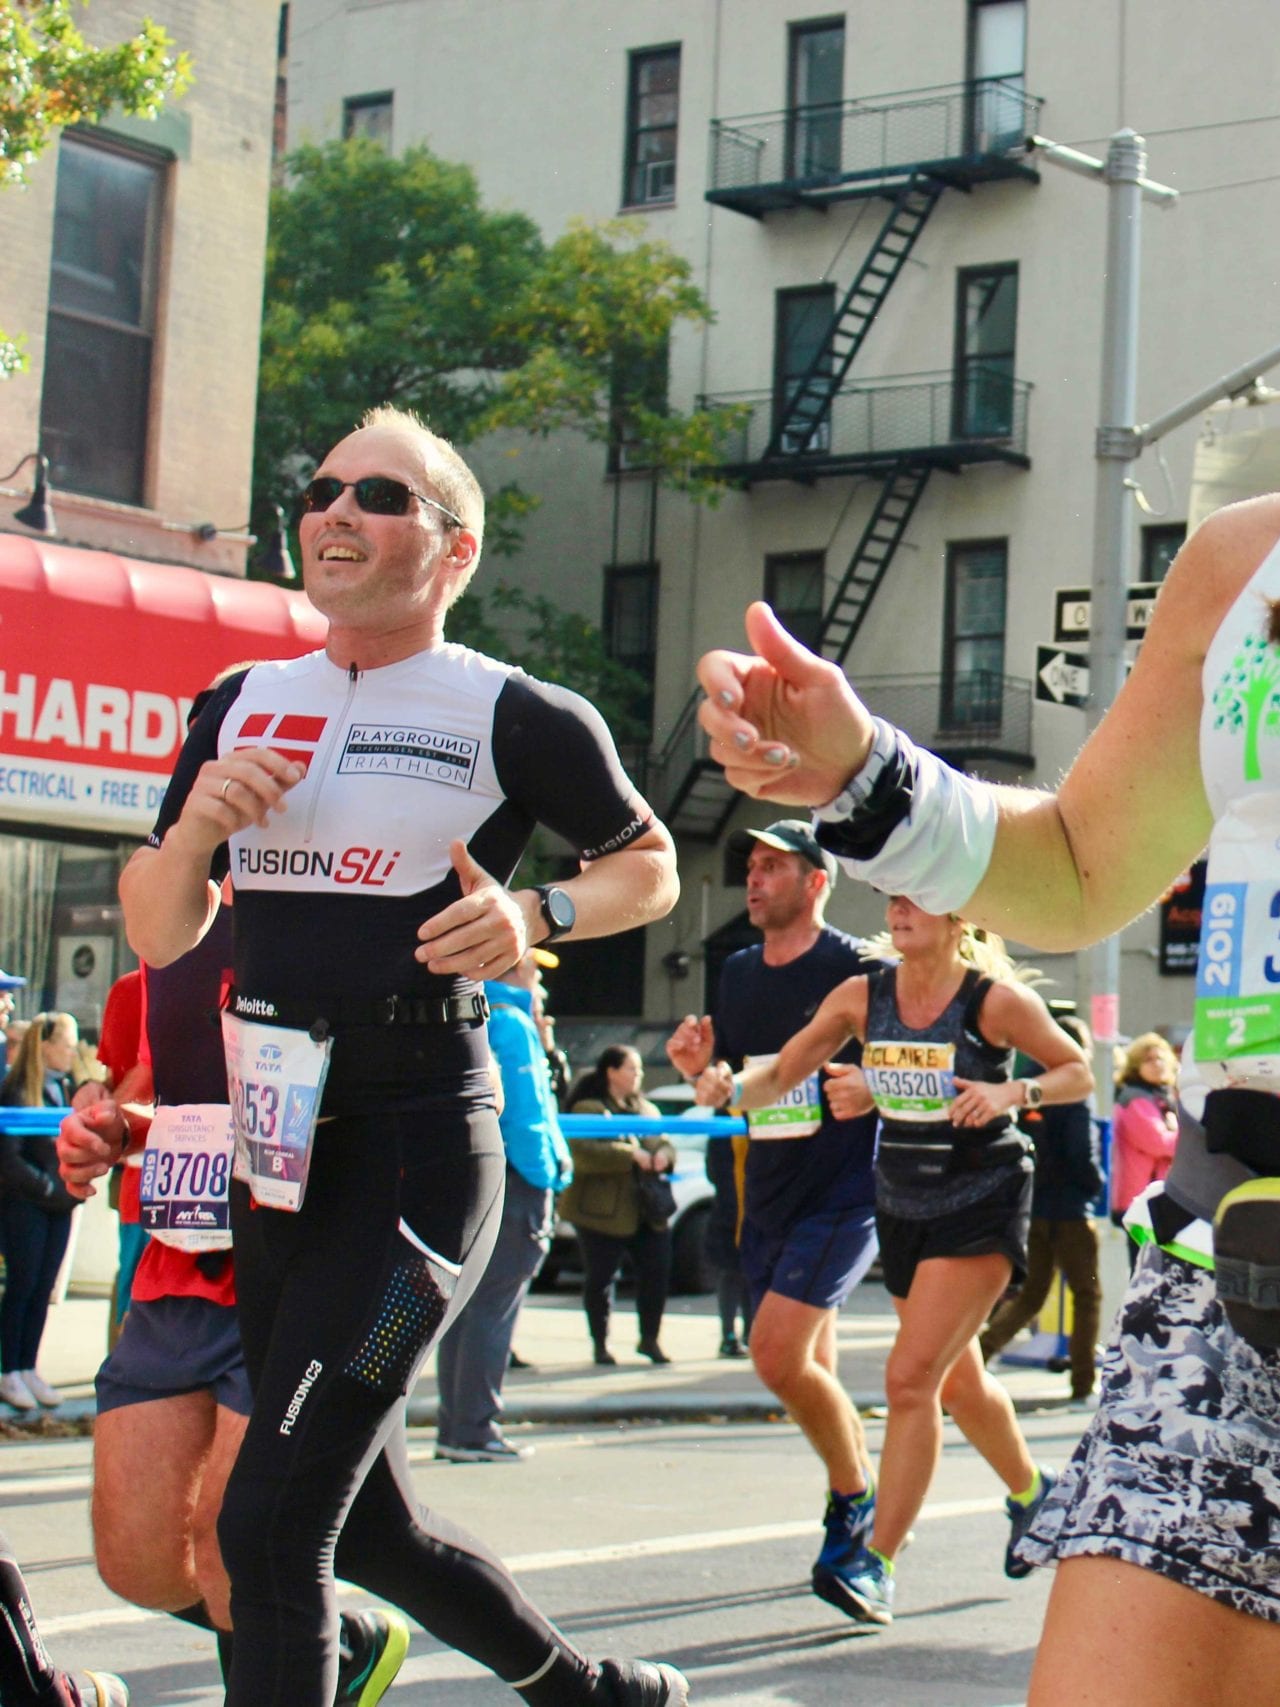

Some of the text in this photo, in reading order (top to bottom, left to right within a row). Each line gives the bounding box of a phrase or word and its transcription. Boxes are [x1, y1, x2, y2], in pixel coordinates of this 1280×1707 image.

[0, 670, 195, 759] HARD
[351, 730, 472, 755] PLAYGROUND
[345, 756, 469, 784] TRIATHLON
[100, 780, 138, 808] FREE
[1204, 893, 1237, 988] 2019
[1227, 1016, 1246, 1046] 2
[256, 1061, 282, 1073] TATA
[871, 1048, 939, 1067] CLAIRE
[879, 1071, 938, 1097] 53520
[181, 1115, 202, 1124] TATA
[142, 1154, 157, 1197] 2019
[158, 1152, 228, 1198] 3708
[272, 1156, 283, 1173] B
[150, 1210, 157, 1224] 3
